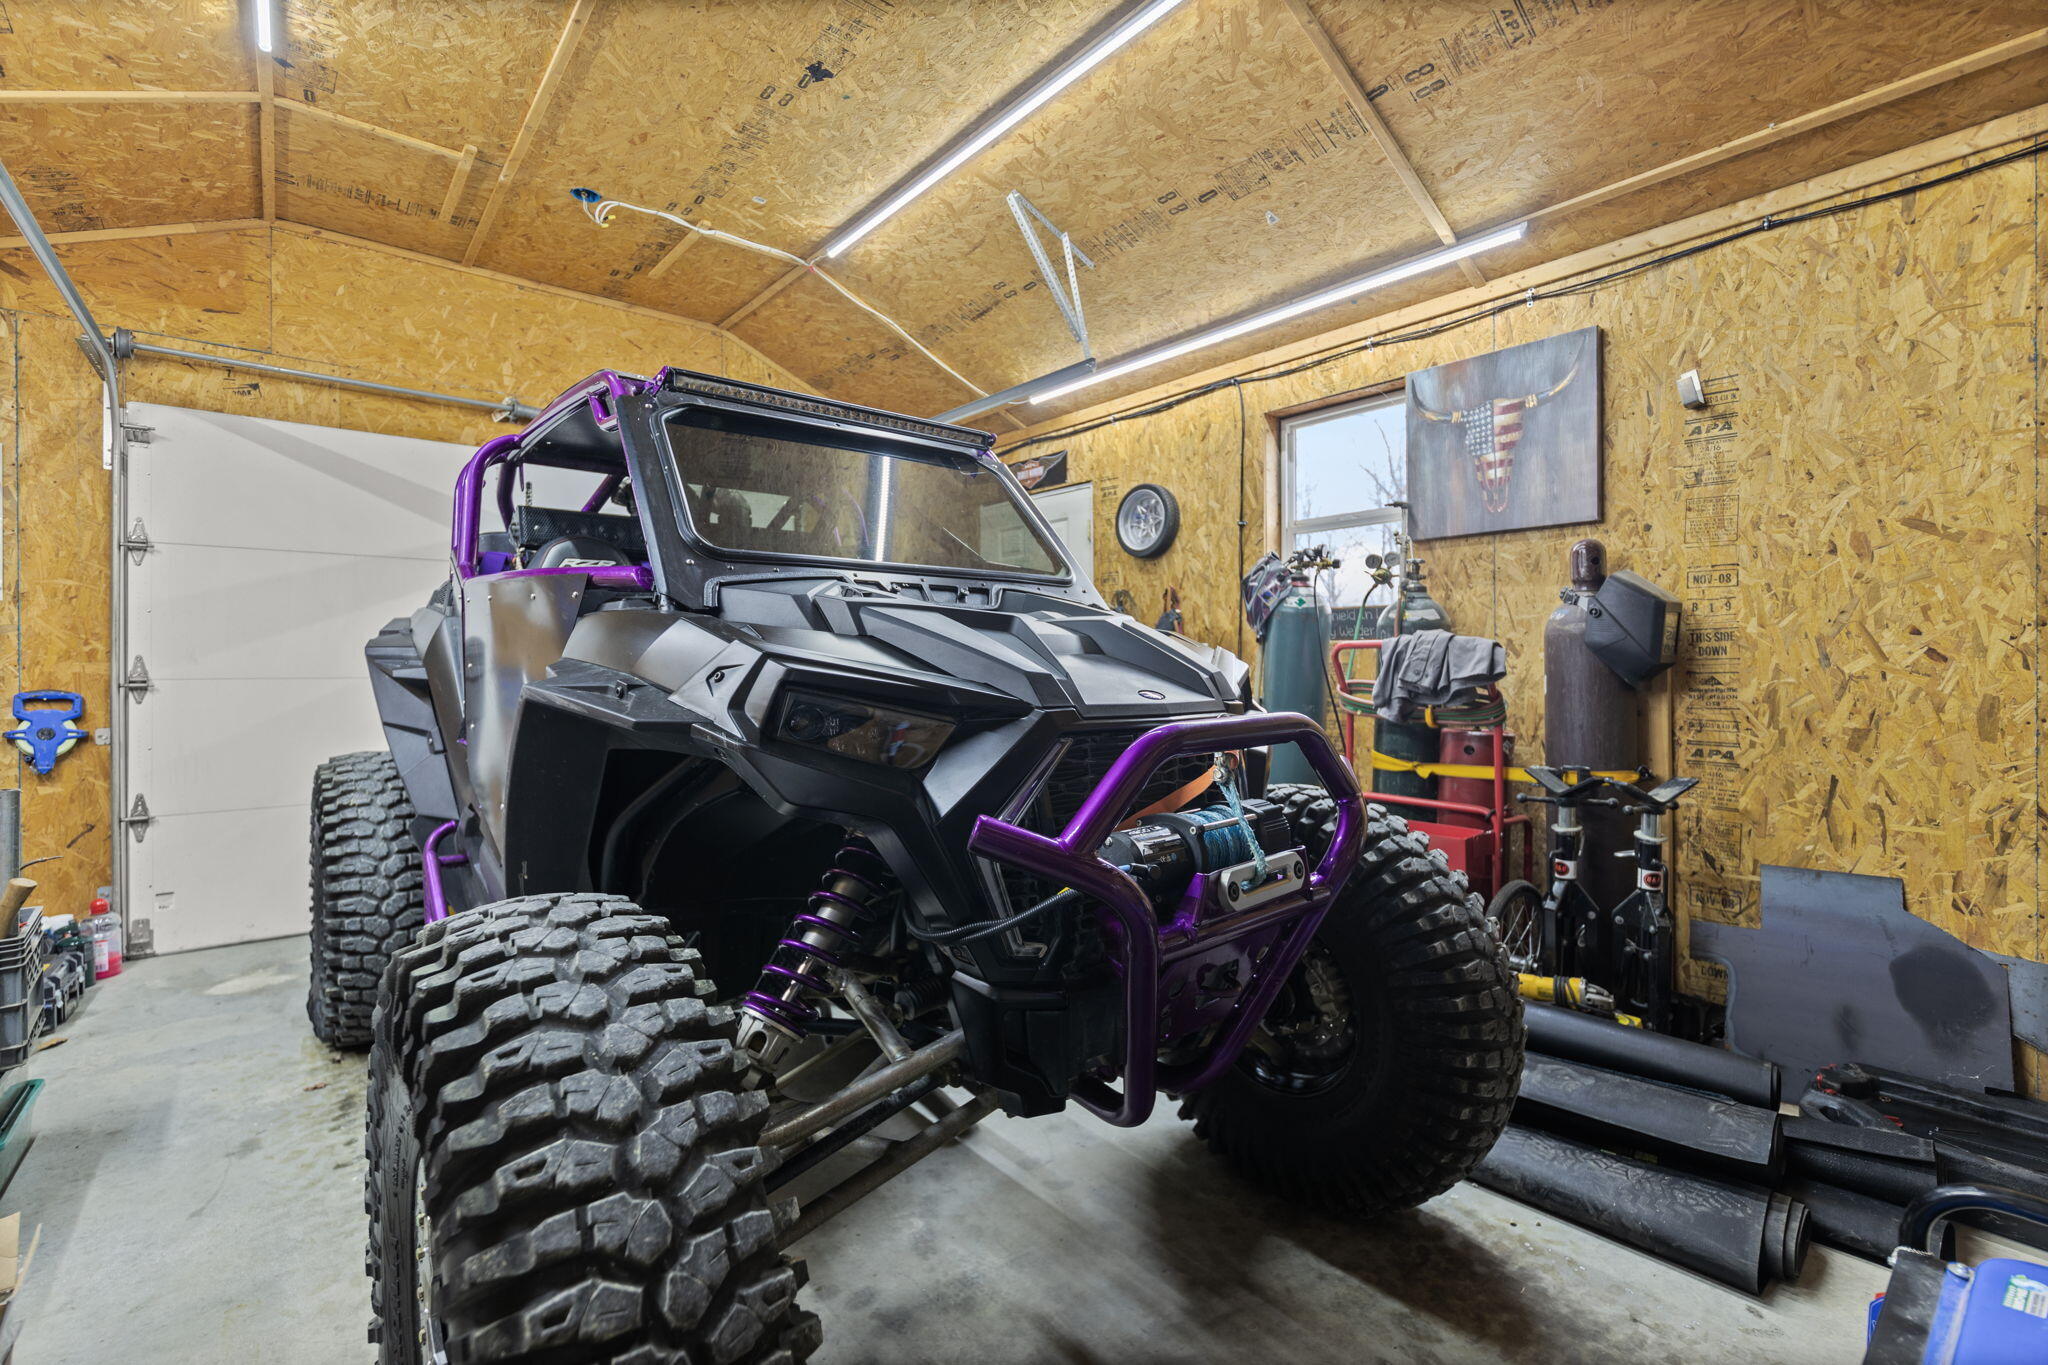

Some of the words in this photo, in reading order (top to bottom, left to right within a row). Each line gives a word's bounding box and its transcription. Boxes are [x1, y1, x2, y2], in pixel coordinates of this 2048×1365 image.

[1689, 420, 1732, 436] APA
[1693, 573, 1733, 585] NOV-08
[1689, 633, 1712, 643] THIS
[1714, 631, 1735, 642] SIDE
[1698, 646, 1728, 657] DOWN
[1691, 748, 1735, 760] APA
